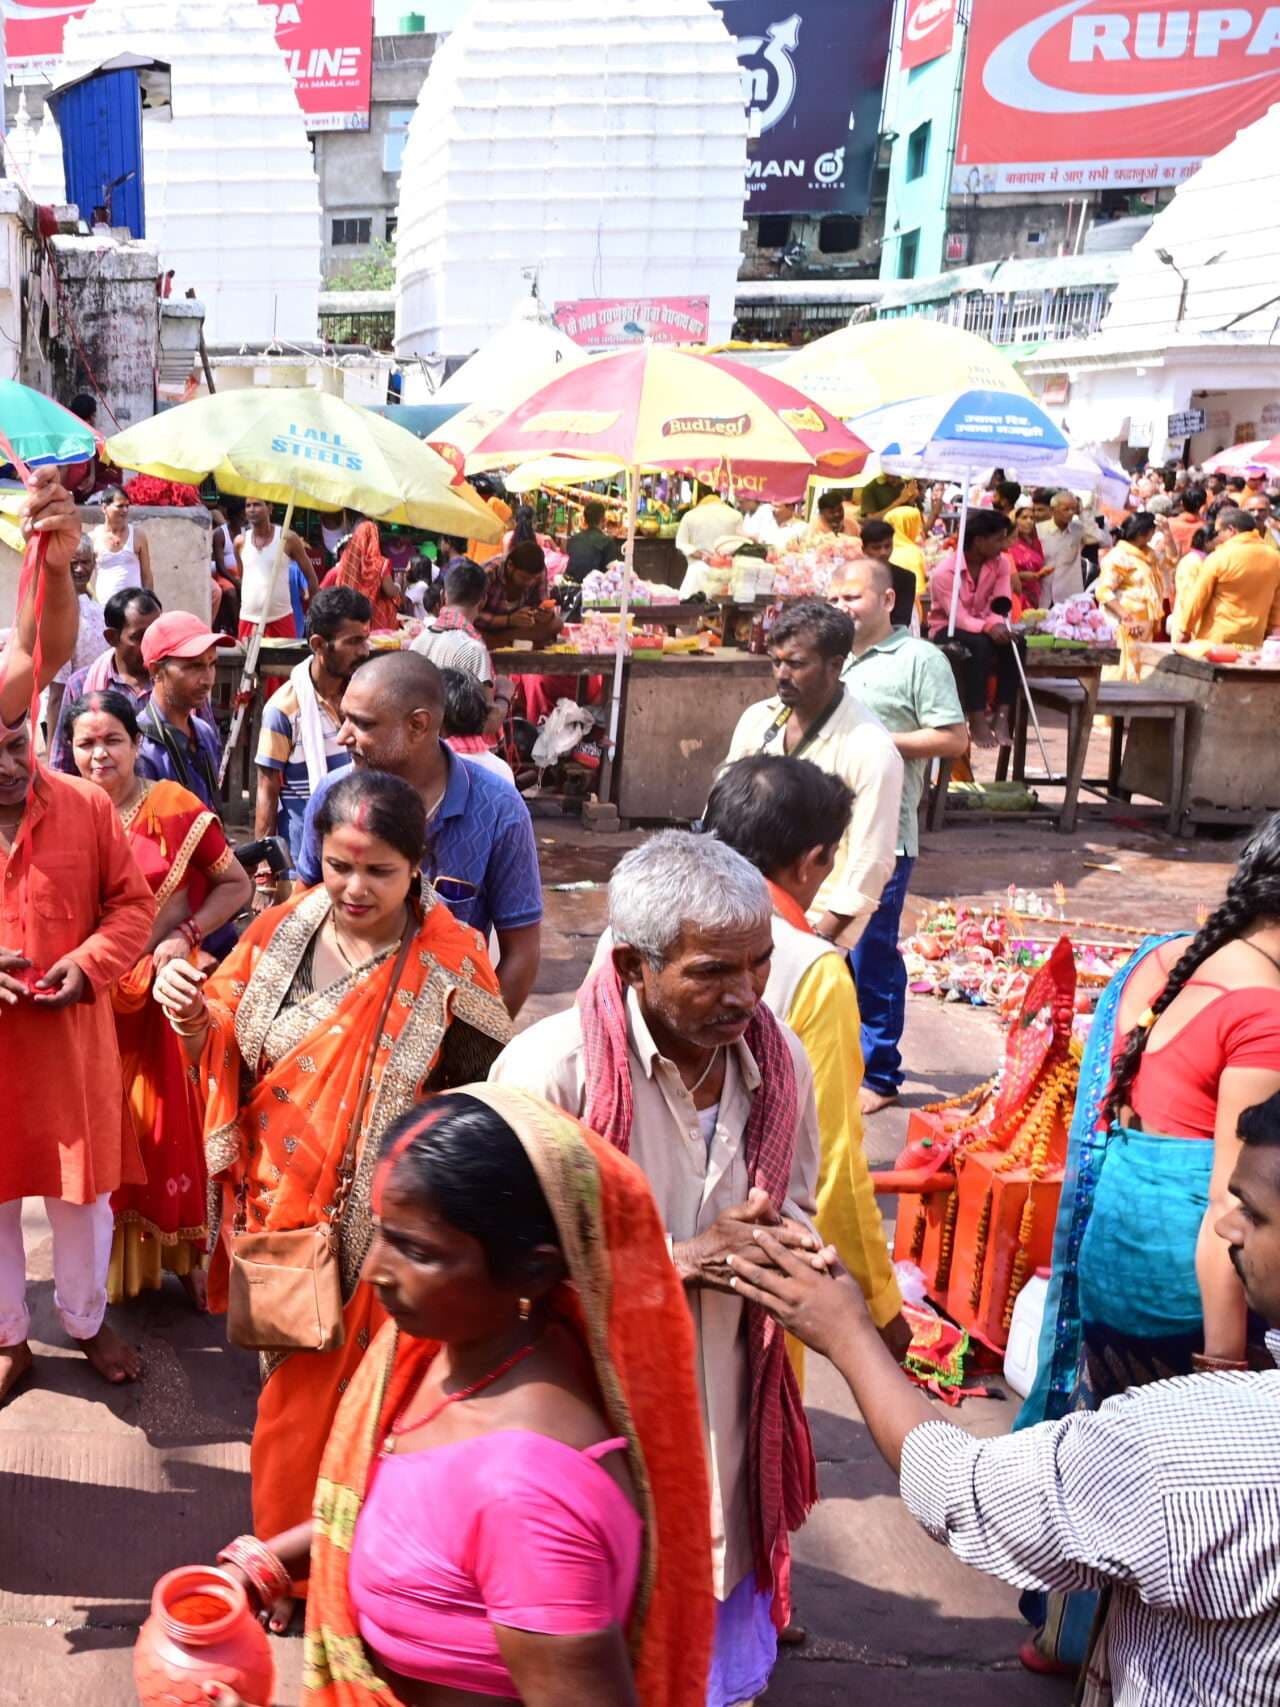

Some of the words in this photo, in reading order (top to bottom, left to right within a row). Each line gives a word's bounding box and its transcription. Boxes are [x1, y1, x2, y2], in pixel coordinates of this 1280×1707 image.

[288, 422, 348, 449] LALL
[669, 416, 747, 434] BudLeaf
[271, 437, 364, 472] STEELS
